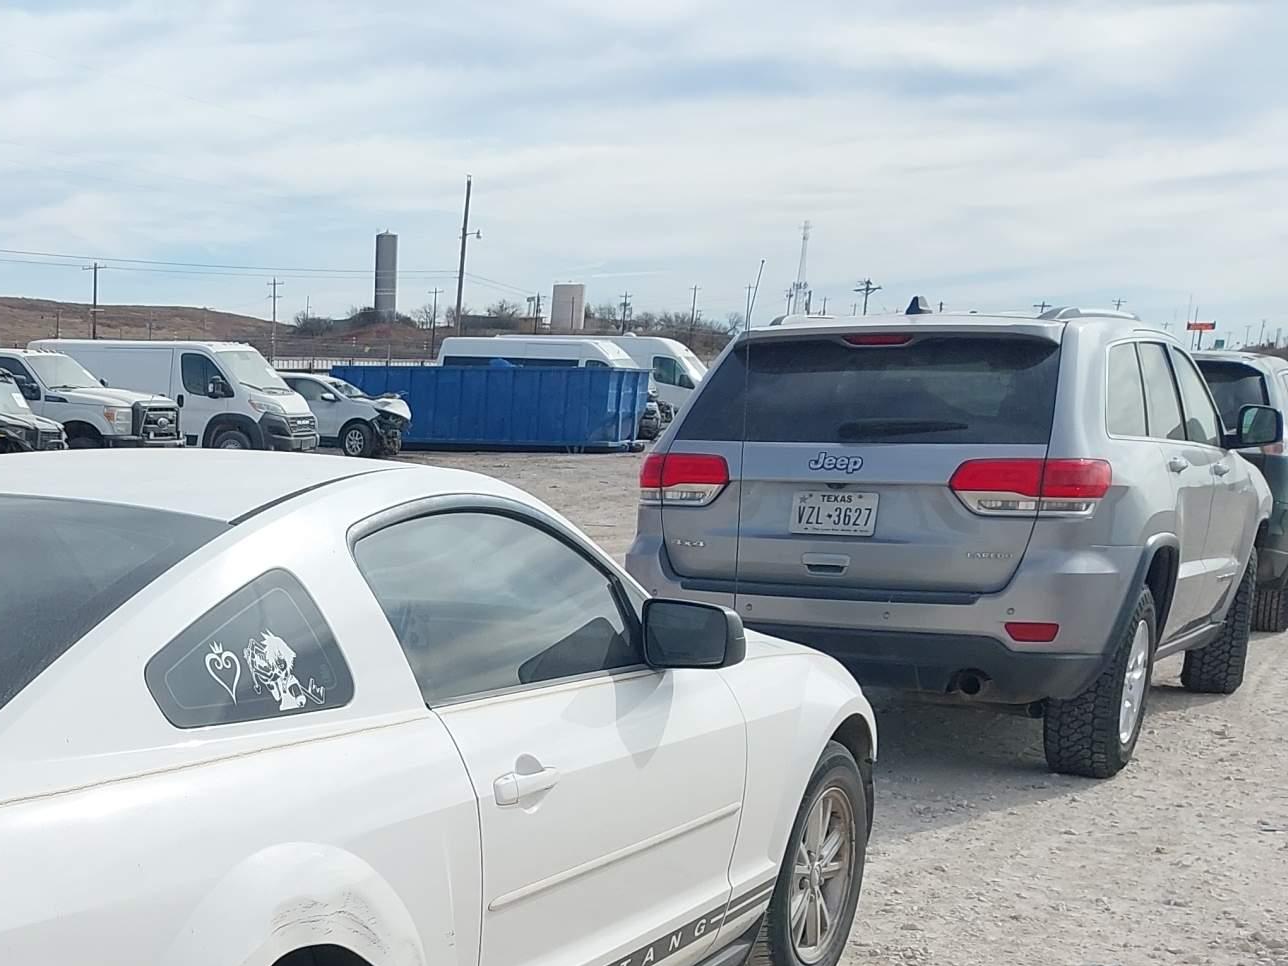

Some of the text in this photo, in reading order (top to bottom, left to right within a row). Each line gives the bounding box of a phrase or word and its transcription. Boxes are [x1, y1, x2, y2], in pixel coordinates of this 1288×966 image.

[808, 451, 863, 474] Jeep
[820, 494, 853, 503] TEXAS
[833, 507, 872, 527] 3627
